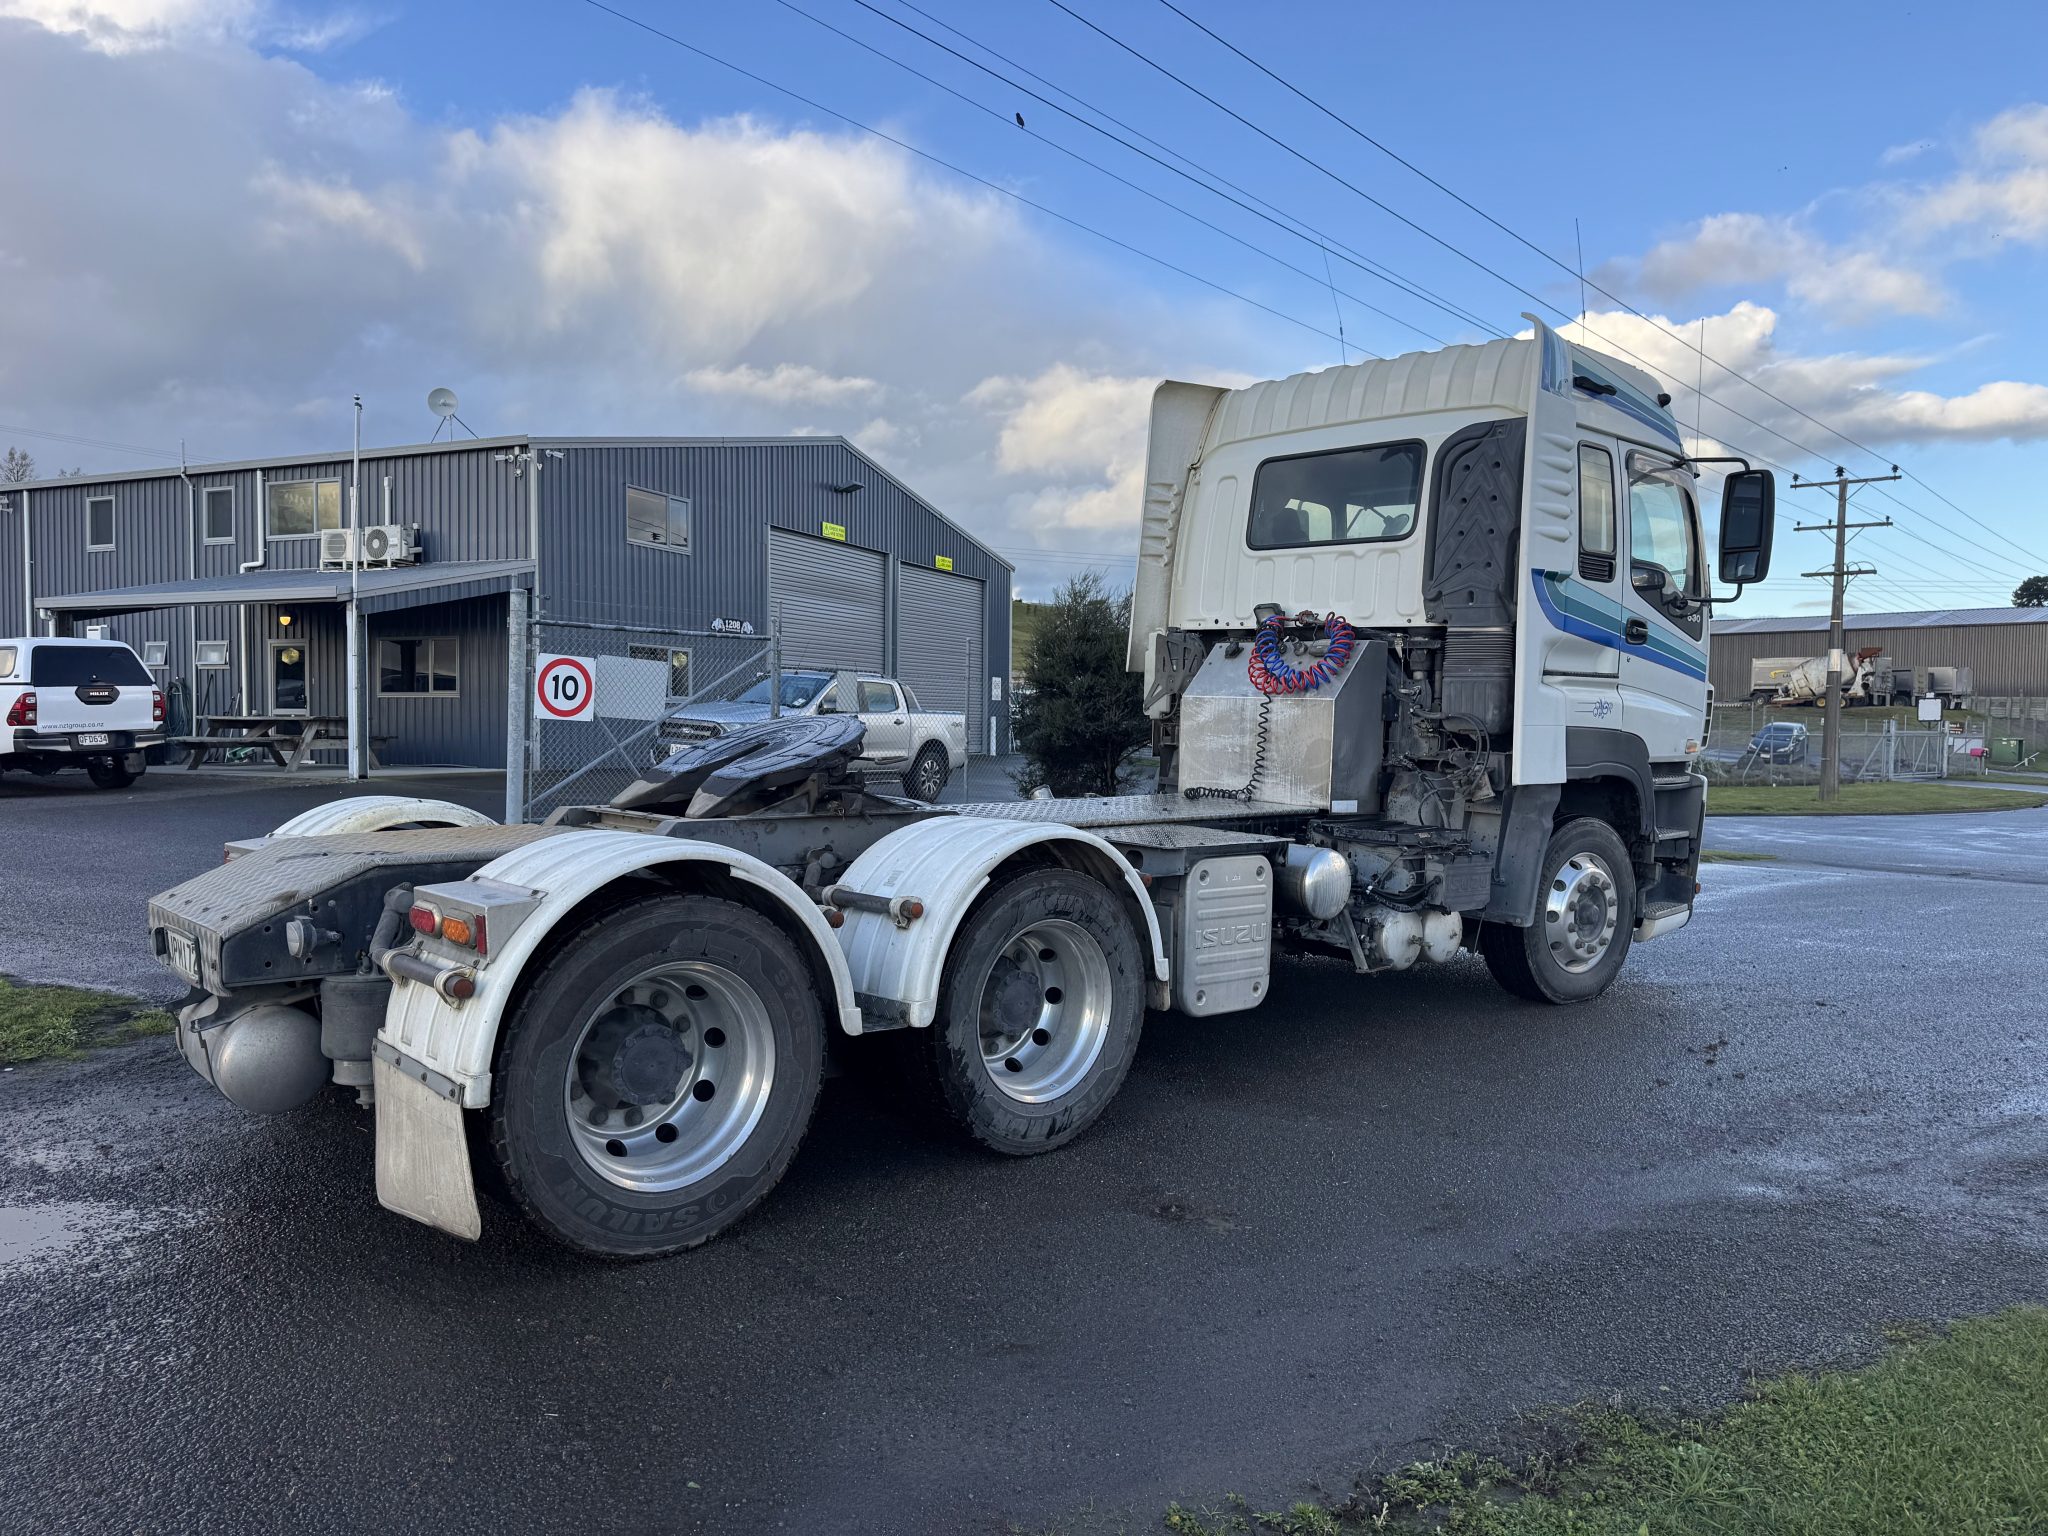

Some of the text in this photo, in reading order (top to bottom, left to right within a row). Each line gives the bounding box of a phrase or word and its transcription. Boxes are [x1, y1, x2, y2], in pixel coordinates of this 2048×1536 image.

[552, 674, 579, 701] 10
[1195, 922, 1267, 949] ISUZU
[556, 1178, 700, 1233] SAILUN
